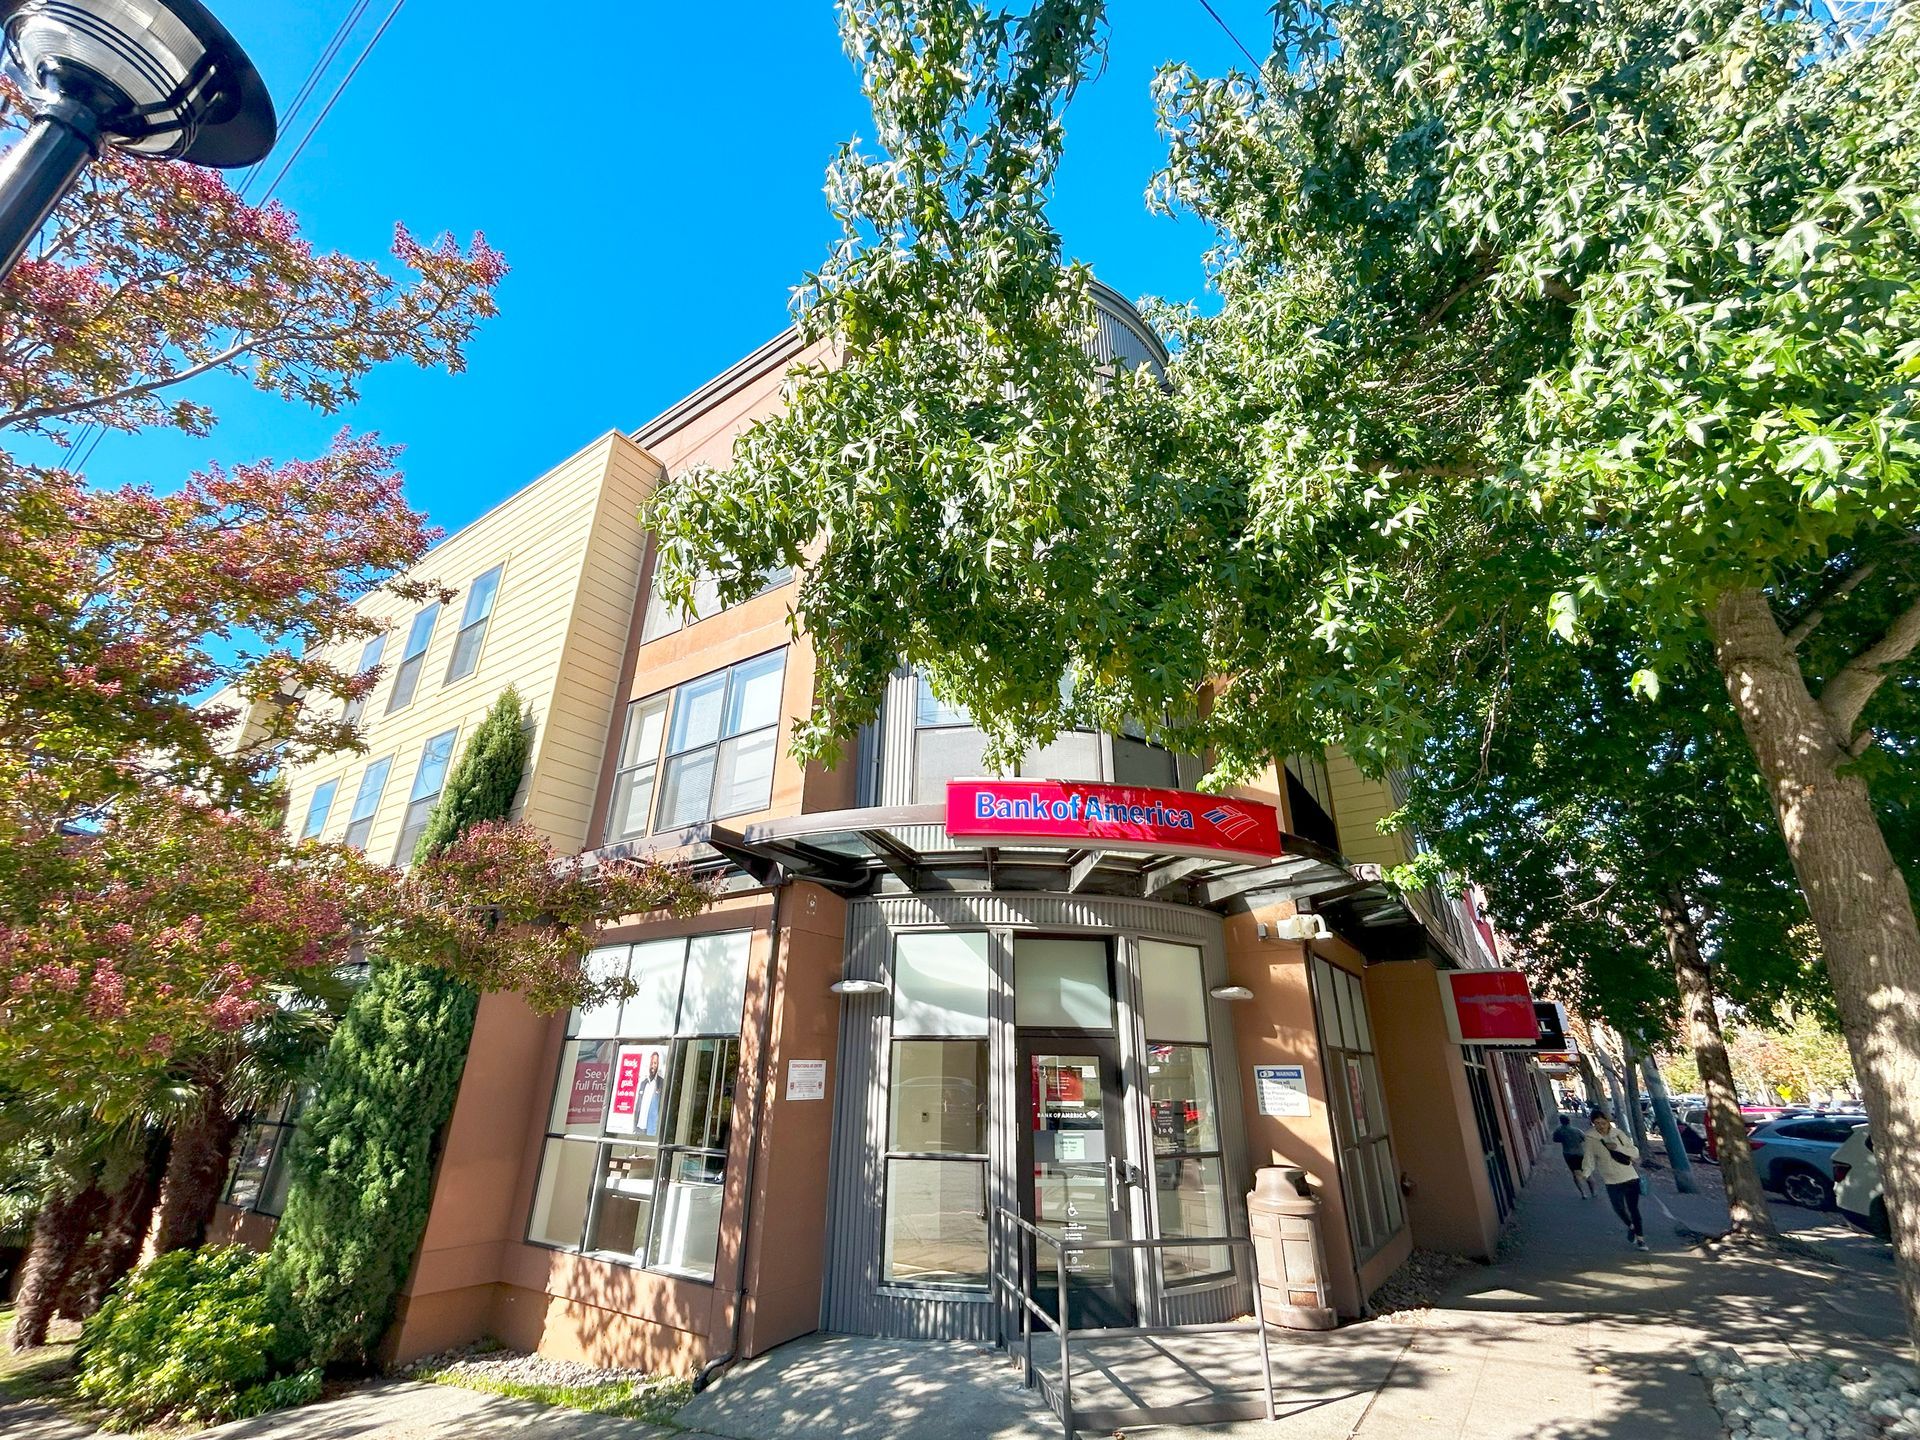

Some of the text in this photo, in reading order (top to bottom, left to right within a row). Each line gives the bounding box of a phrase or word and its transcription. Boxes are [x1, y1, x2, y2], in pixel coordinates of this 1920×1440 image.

[976, 792, 1195, 829] Bank of America
[584, 1068, 602, 1079] See
[575, 1080, 590, 1091] full
